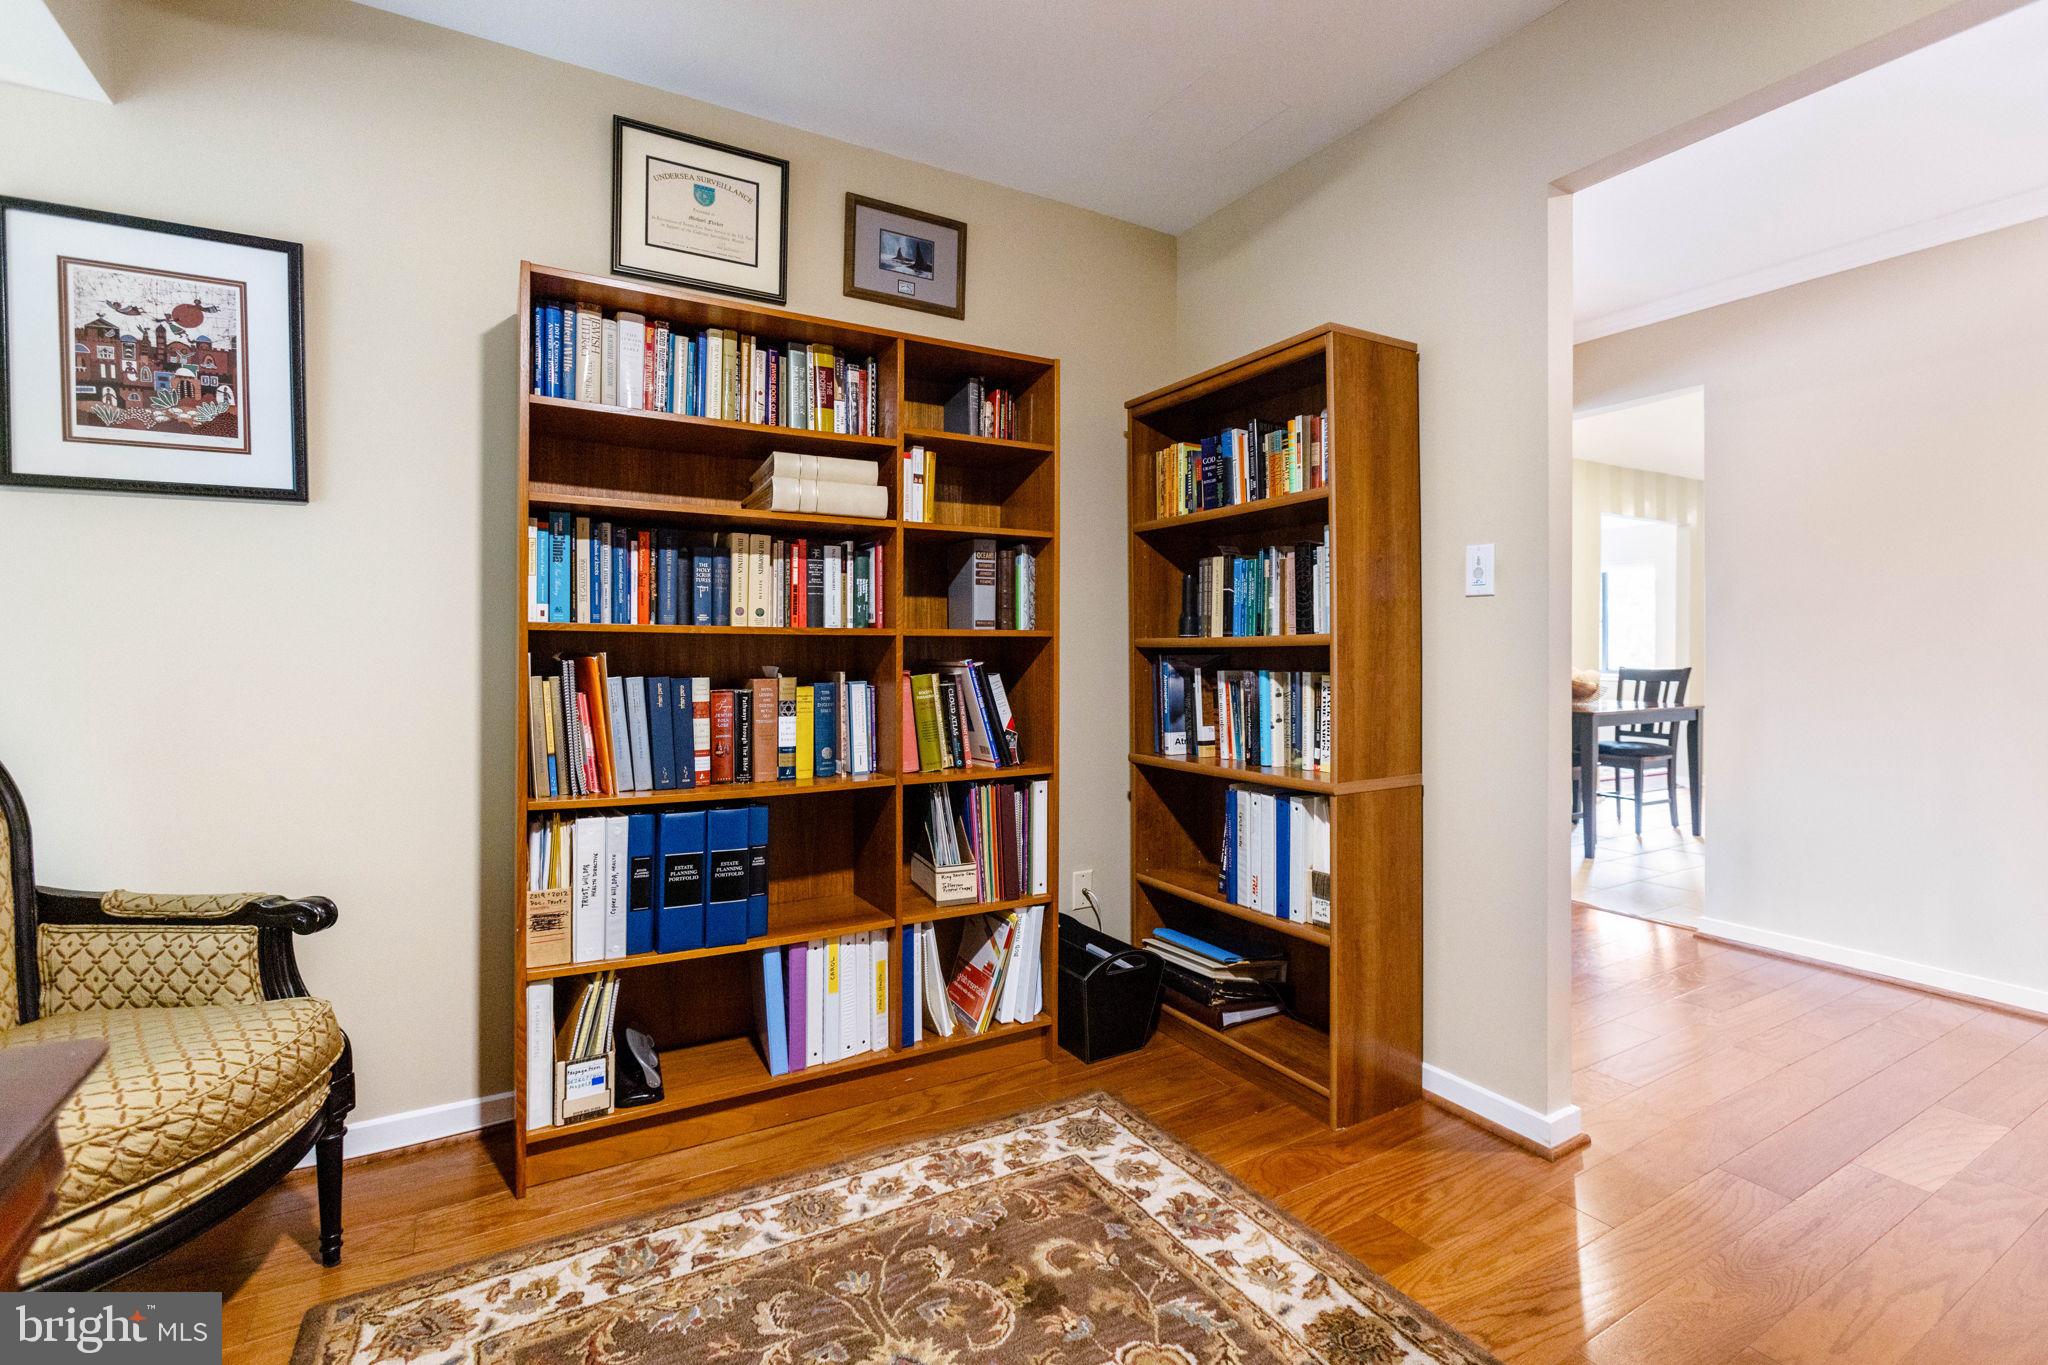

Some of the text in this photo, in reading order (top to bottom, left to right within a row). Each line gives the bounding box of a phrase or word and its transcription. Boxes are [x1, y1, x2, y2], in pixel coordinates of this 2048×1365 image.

[653, 172, 754, 205] UNDERSEA SURVEILLANCE
[563, 310, 574, 372] Ethical Wills
[580, 317, 591, 357] LITERACY
[590, 317, 601, 355] JEWISH
[818, 370, 827, 404] PROPHETS
[1203, 456, 1215, 465] GOD
[553, 535, 566, 563] China
[948, 688, 956, 714] CLOUD
[951, 715, 959, 736] ATLAS
[670, 869, 698, 877] PLANNING
[714, 870, 744, 878] PORTFOLIO
